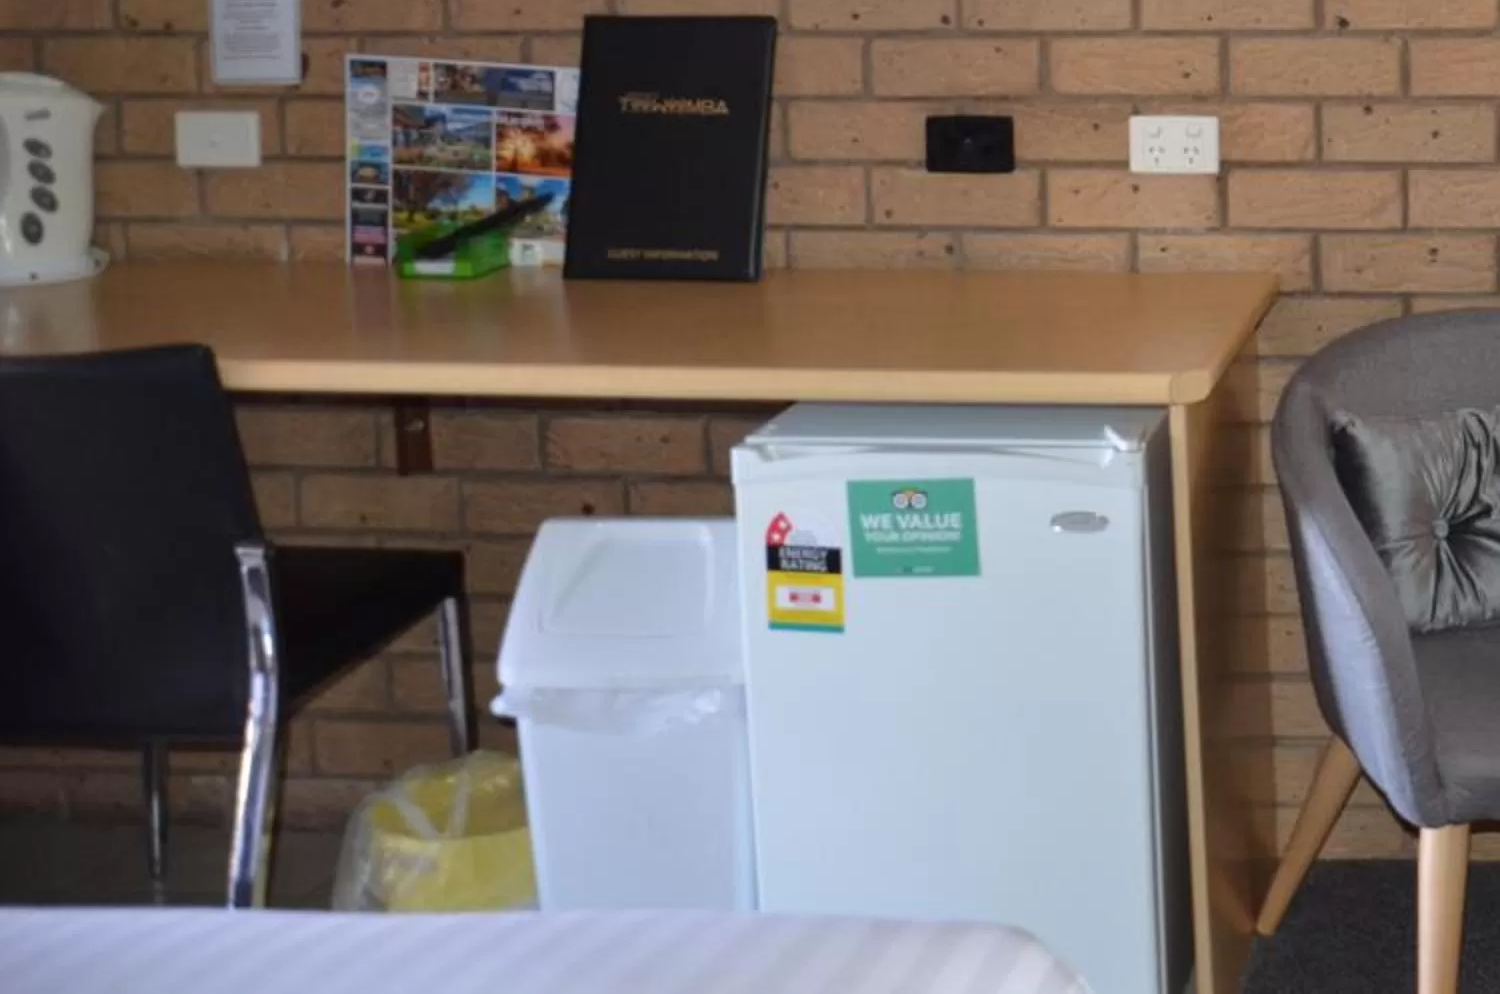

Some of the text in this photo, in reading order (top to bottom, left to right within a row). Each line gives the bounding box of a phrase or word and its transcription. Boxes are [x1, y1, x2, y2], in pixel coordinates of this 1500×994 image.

[860, 512, 962, 529] WE VALUE
[863, 530, 900, 542] YOUR
